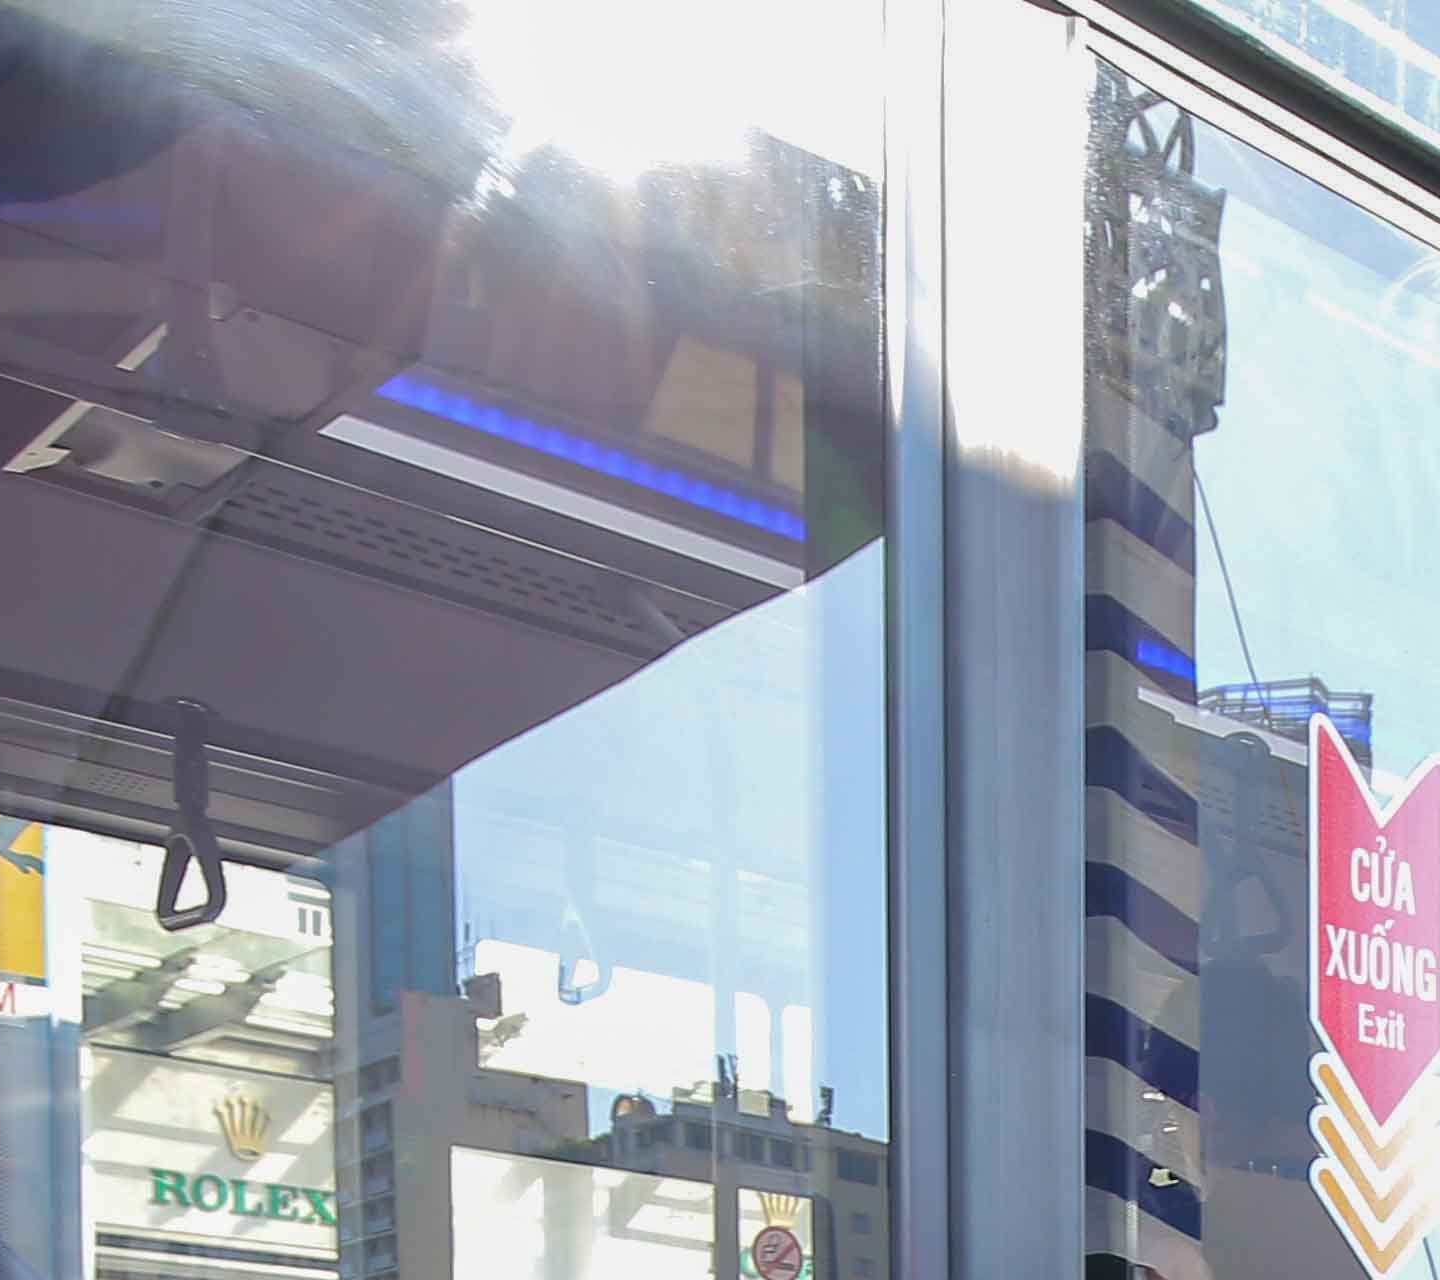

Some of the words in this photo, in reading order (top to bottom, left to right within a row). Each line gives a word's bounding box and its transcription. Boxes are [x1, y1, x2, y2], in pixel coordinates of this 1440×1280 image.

[1350, 835, 1416, 916] CỬA
[1325, 919, 1440, 1002] XUỐNG
[1358, 1003, 1407, 1051] Exit
[147, 1167, 337, 1226] ROLEX
